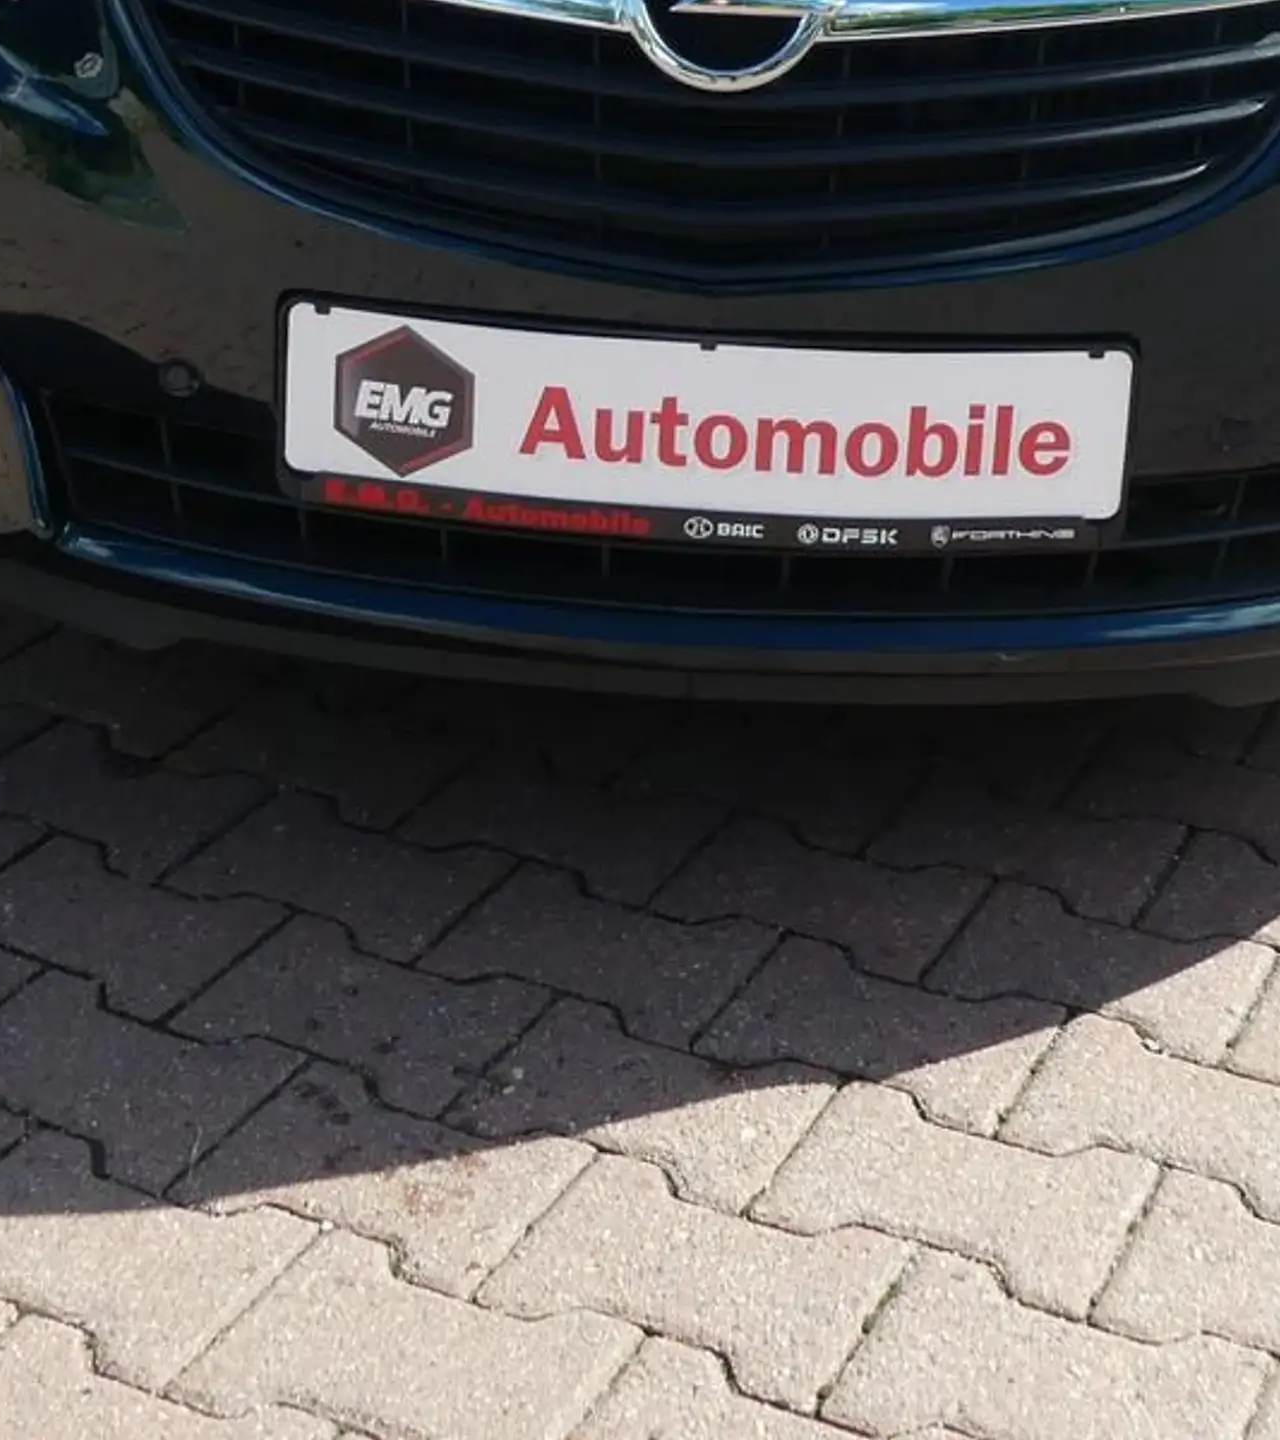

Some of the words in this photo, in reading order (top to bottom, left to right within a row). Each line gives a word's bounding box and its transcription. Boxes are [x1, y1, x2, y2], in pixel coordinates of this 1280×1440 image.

[354, 378, 455, 428] EMG
[519, 385, 1071, 478] Automobile
[461, 496, 652, 536] Automobile
[717, 521, 765, 540] BAIC
[822, 527, 899, 545] DFSK
